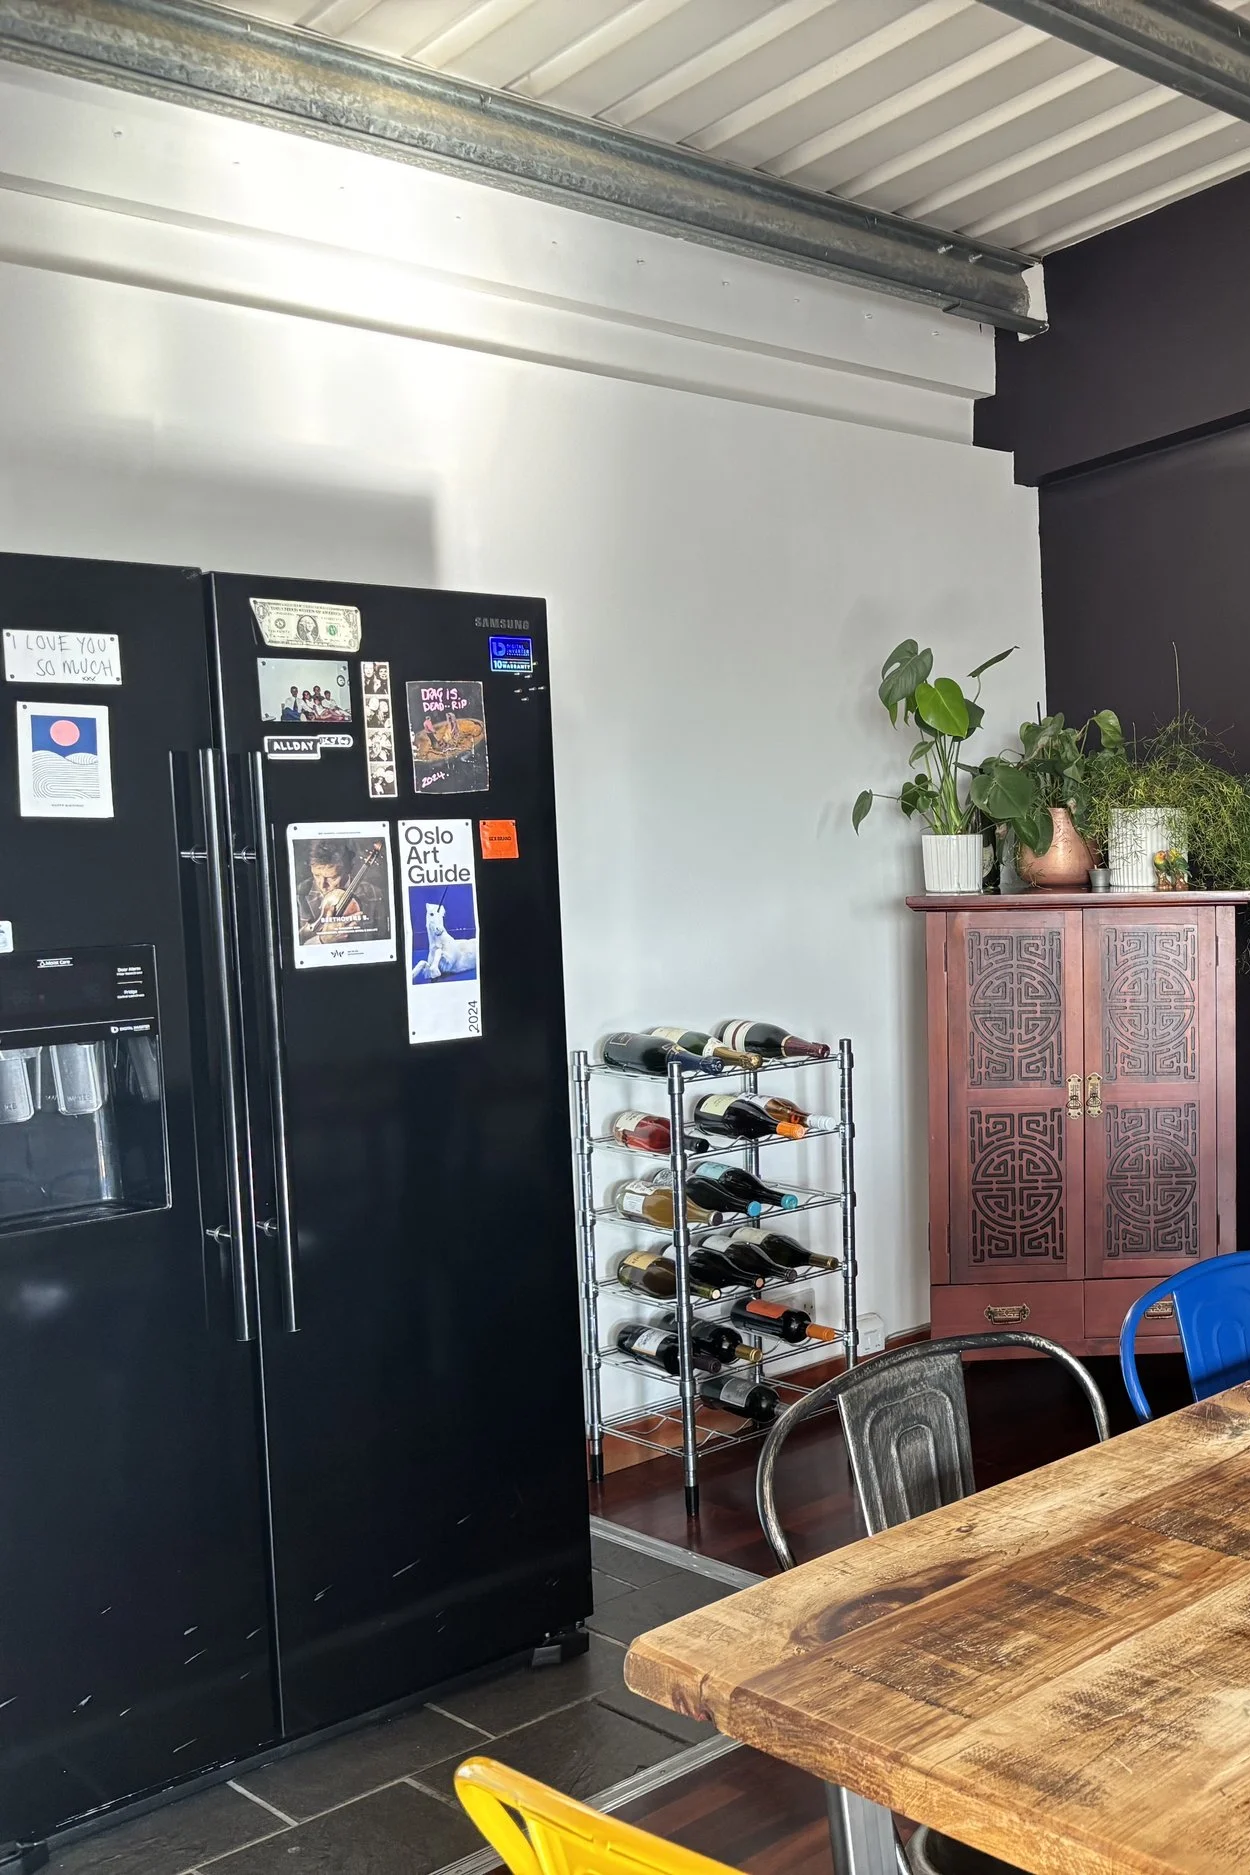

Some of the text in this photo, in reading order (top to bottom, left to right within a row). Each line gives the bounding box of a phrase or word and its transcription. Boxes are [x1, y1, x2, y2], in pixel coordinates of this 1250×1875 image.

[475, 617, 529, 630] SAMSUNG
[13, 635, 106, 654] I LOVE YOU
[36, 658, 113, 676] SO MUCH
[493, 660, 502, 669] 10
[273, 741, 314, 751] ALLDAY
[404, 826, 454, 845] Oslo
[406, 846, 440, 864] Art
[408, 864, 471, 884] Guide
[468, 1000, 478, 1033] 2024
